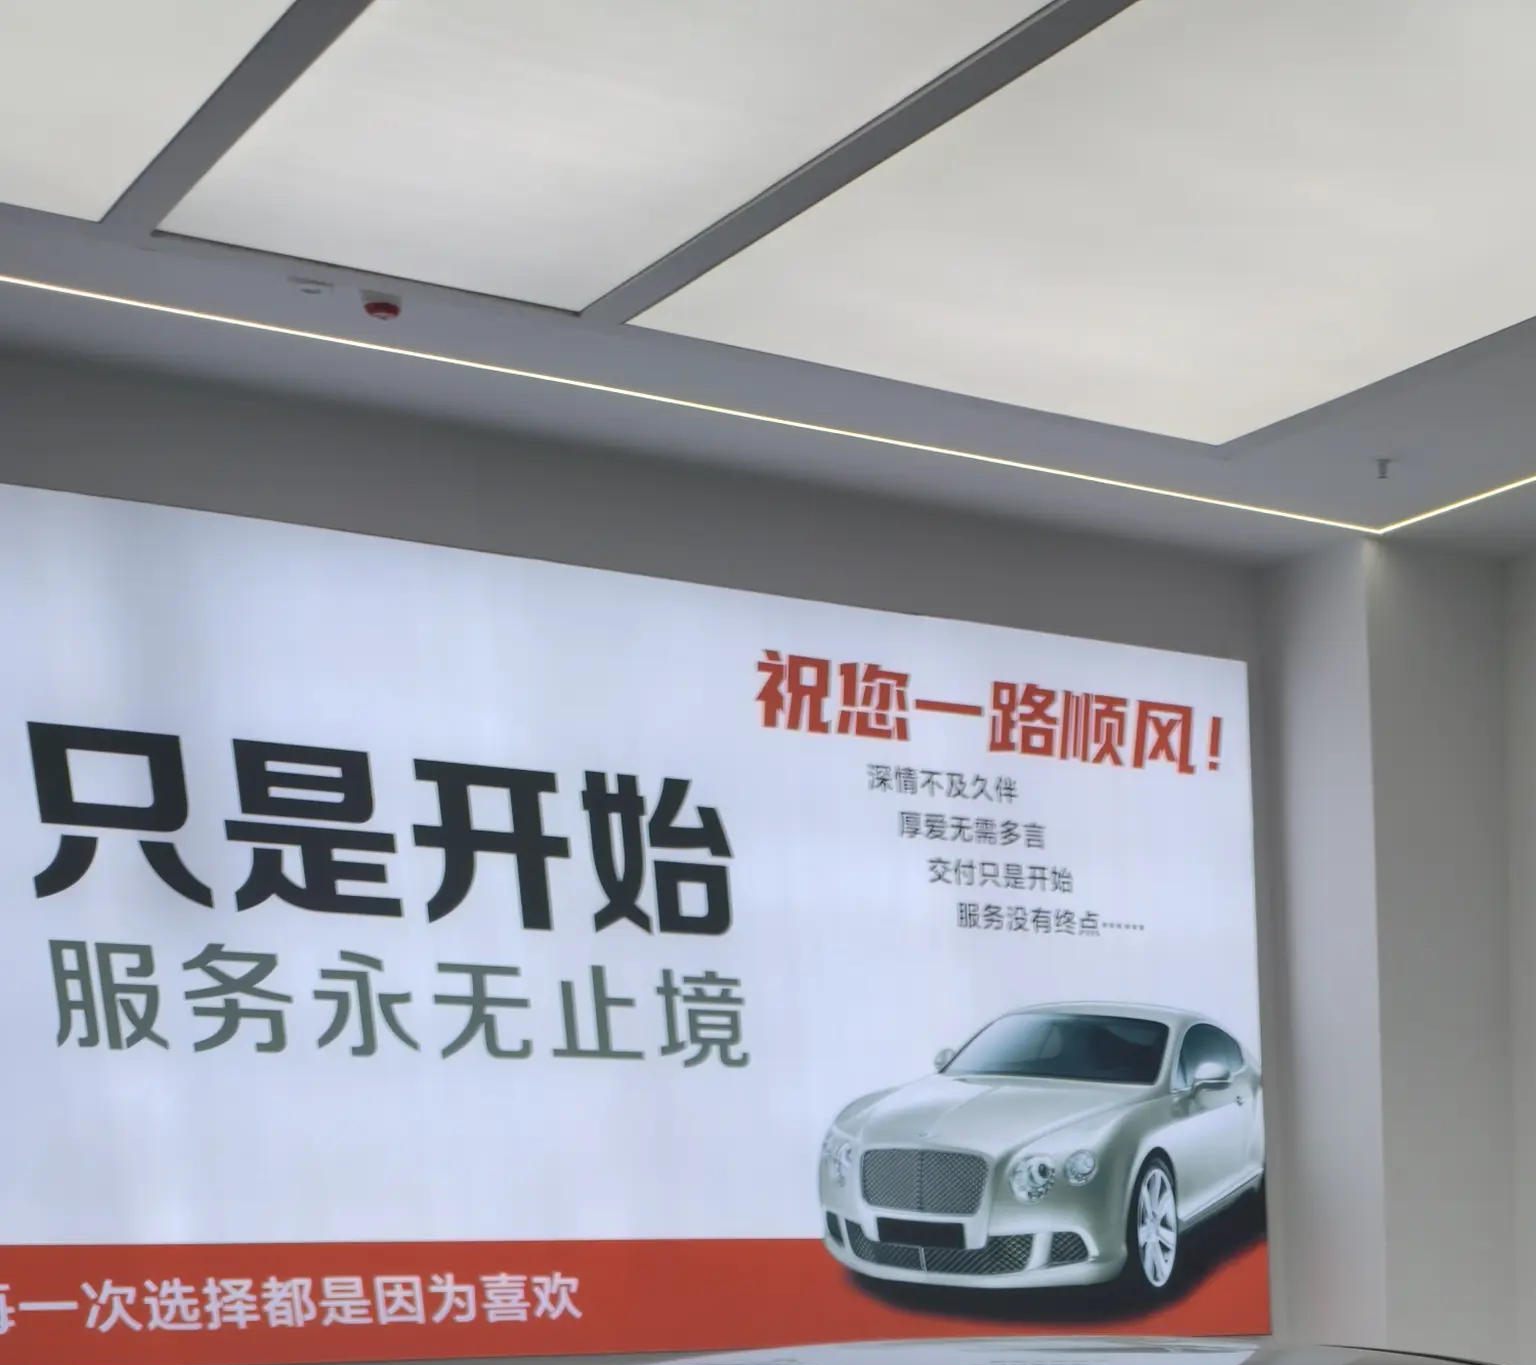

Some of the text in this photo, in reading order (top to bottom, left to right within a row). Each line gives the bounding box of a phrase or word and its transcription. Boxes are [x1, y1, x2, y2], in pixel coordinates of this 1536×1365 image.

[755, 650, 1223, 775] 祝您一路顺风！
[867, 763, 1019, 803] 深情不及久伴
[27, 721, 733, 936] 只是开始
[899, 811, 1046, 849] 厚爱无需多言
[927, 856, 1073, 893] 交付只是开始
[48, 939, 750, 1068] 服务永无止境
[0, 1271, 584, 1335] 一次选择都是因为喜欢
